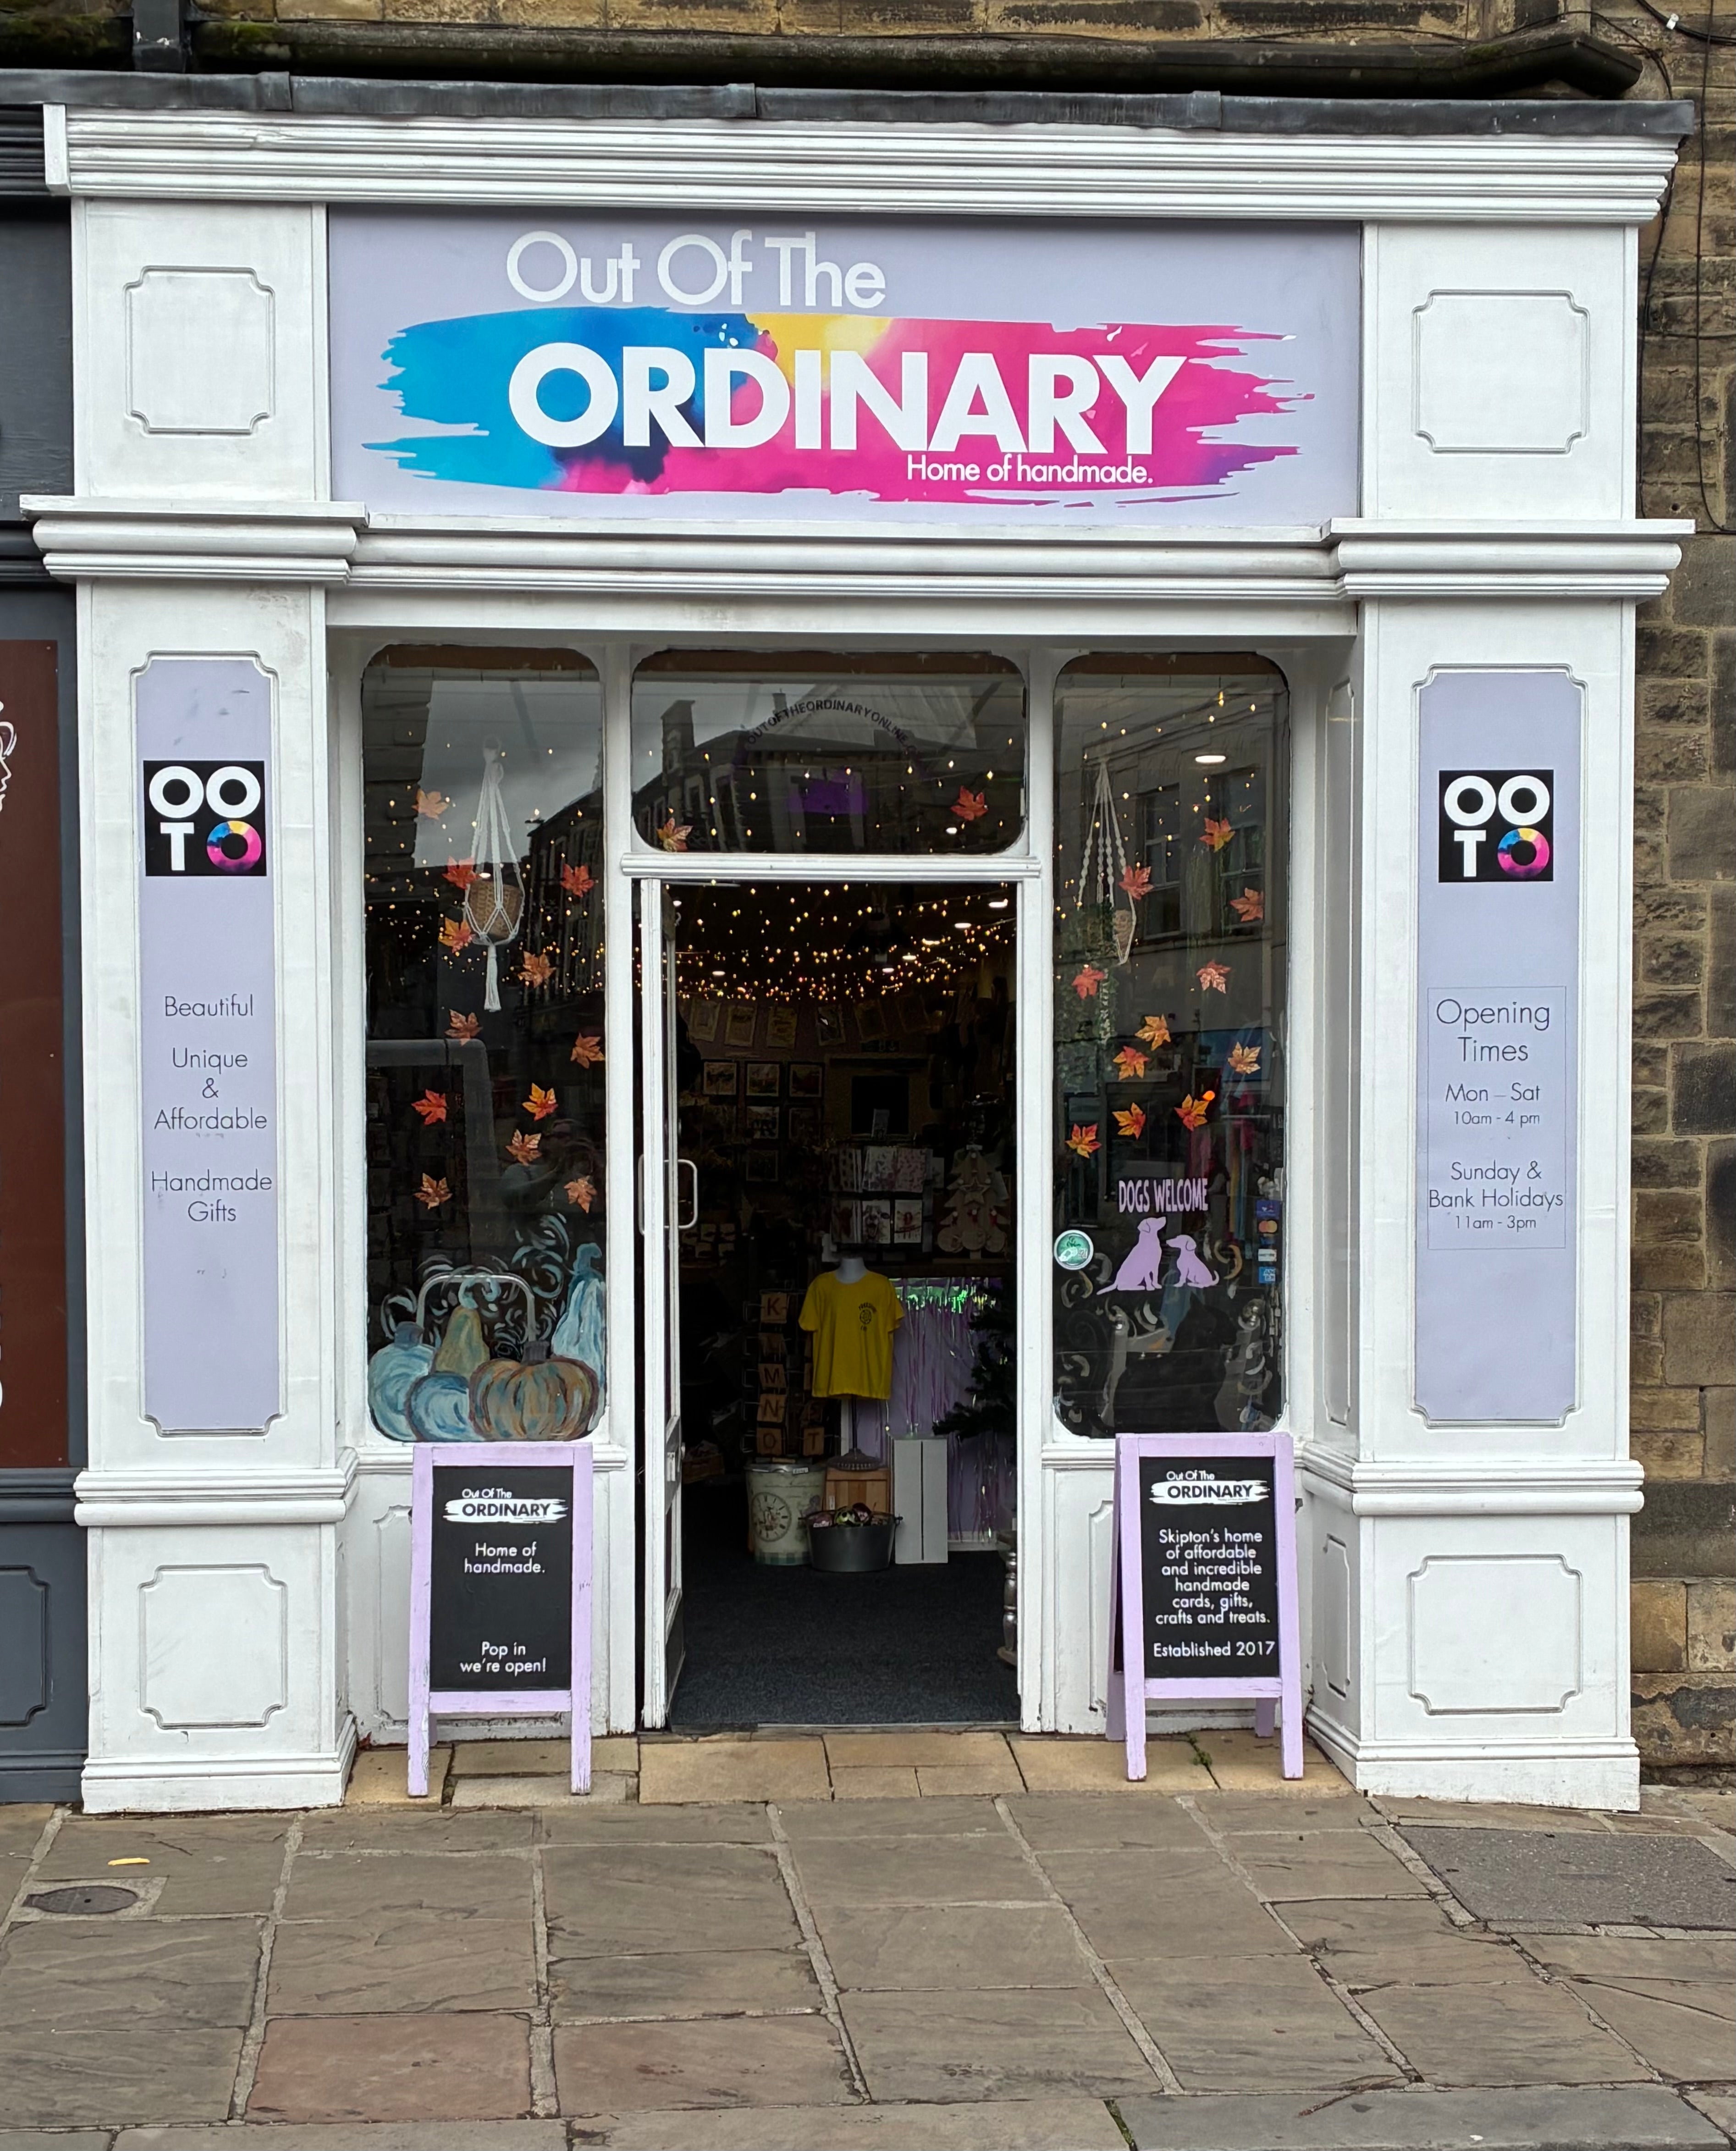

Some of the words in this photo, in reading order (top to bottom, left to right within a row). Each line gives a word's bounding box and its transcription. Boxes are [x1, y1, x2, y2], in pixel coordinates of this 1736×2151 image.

[507, 233, 640, 304] Out
[657, 231, 753, 305] Of
[766, 231, 887, 308] The
[507, 341, 1189, 456] ORDINARY
[908, 454, 980, 481] Home
[986, 453, 1012, 481] of
[1017, 453, 1153, 483] handmade.
[149, 766, 261, 818] OO
[1444, 775, 1550, 826] OO
[160, 821, 261, 871] TO
[1454, 828, 1549, 877] TO
[165, 994, 253, 1017] Beautiful
[1436, 999, 1549, 1032] Opening
[1457, 1036, 1528, 1062] Times
[173, 1047, 248, 1074] Unique
[202, 1078, 219, 1099] &
[1445, 1084, 1488, 1102] Mon
[1510, 1082, 1540, 1101] Sat
[154, 1107, 267, 1129] Affordable
[1455, 1111, 1492, 1125] 10am
[1505, 1111, 1514, 1123] 4
[1520, 1115, 1540, 1128] pm
[152, 1169, 272, 1192] Handmade
[1451, 1160, 1520, 1185] Sunday
[1527, 1161, 1542, 1179] &
[1119, 1179, 1150, 1213] DOGS
[1153, 1178, 1208, 1212] WELCOME
[1429, 1188, 1474, 1208] Bank
[1482, 1186, 1563, 1212] Holidays
[188, 1199, 236, 1222] Gifts
[1456, 1216, 1493, 1229] 11am
[1507, 1215, 1536, 1232] 3pm
[1166, 1471, 1184, 1481] Out
[1185, 1470, 1197, 1480] Of
[1198, 1470, 1215, 1481] The
[462, 1488, 479, 1499] Out
[481, 1487, 495, 1499] Of
[496, 1488, 512, 1499] The
[1167, 1484, 1253, 1498] ORDINARY
[462, 1503, 551, 1516] ORDINARY
[1159, 1528, 1220, 1548] Skipton's
[1224, 1527, 1262, 1542] home
[475, 1543, 518, 1557] Home
[522, 1541, 537, 1556] of
[1166, 1545, 1180, 1559] of
[1185, 1543, 1257, 1559] affordable
[464, 1558, 545, 1573] handmade.
[1162, 1561, 1188, 1576] and
[1194, 1559, 1262, 1575] incredible
[1175, 1577, 1250, 1592] handmade
[1172, 1594, 1214, 1611] cards,
[1220, 1592, 1253, 1613] gifts,
[1155, 1611, 1193, 1625] crafts
[1197, 1609, 1225, 1624] and
[1229, 1611, 1270, 1623] treats.
[482, 1641, 508, 1659] Pop
[513, 1642, 526, 1655] in
[1153, 1641, 1231, 1657] Established
[1236, 1641, 1275, 1656] 2017
[460, 1657, 501, 1672] we're
[505, 1658, 546, 1676] open!
